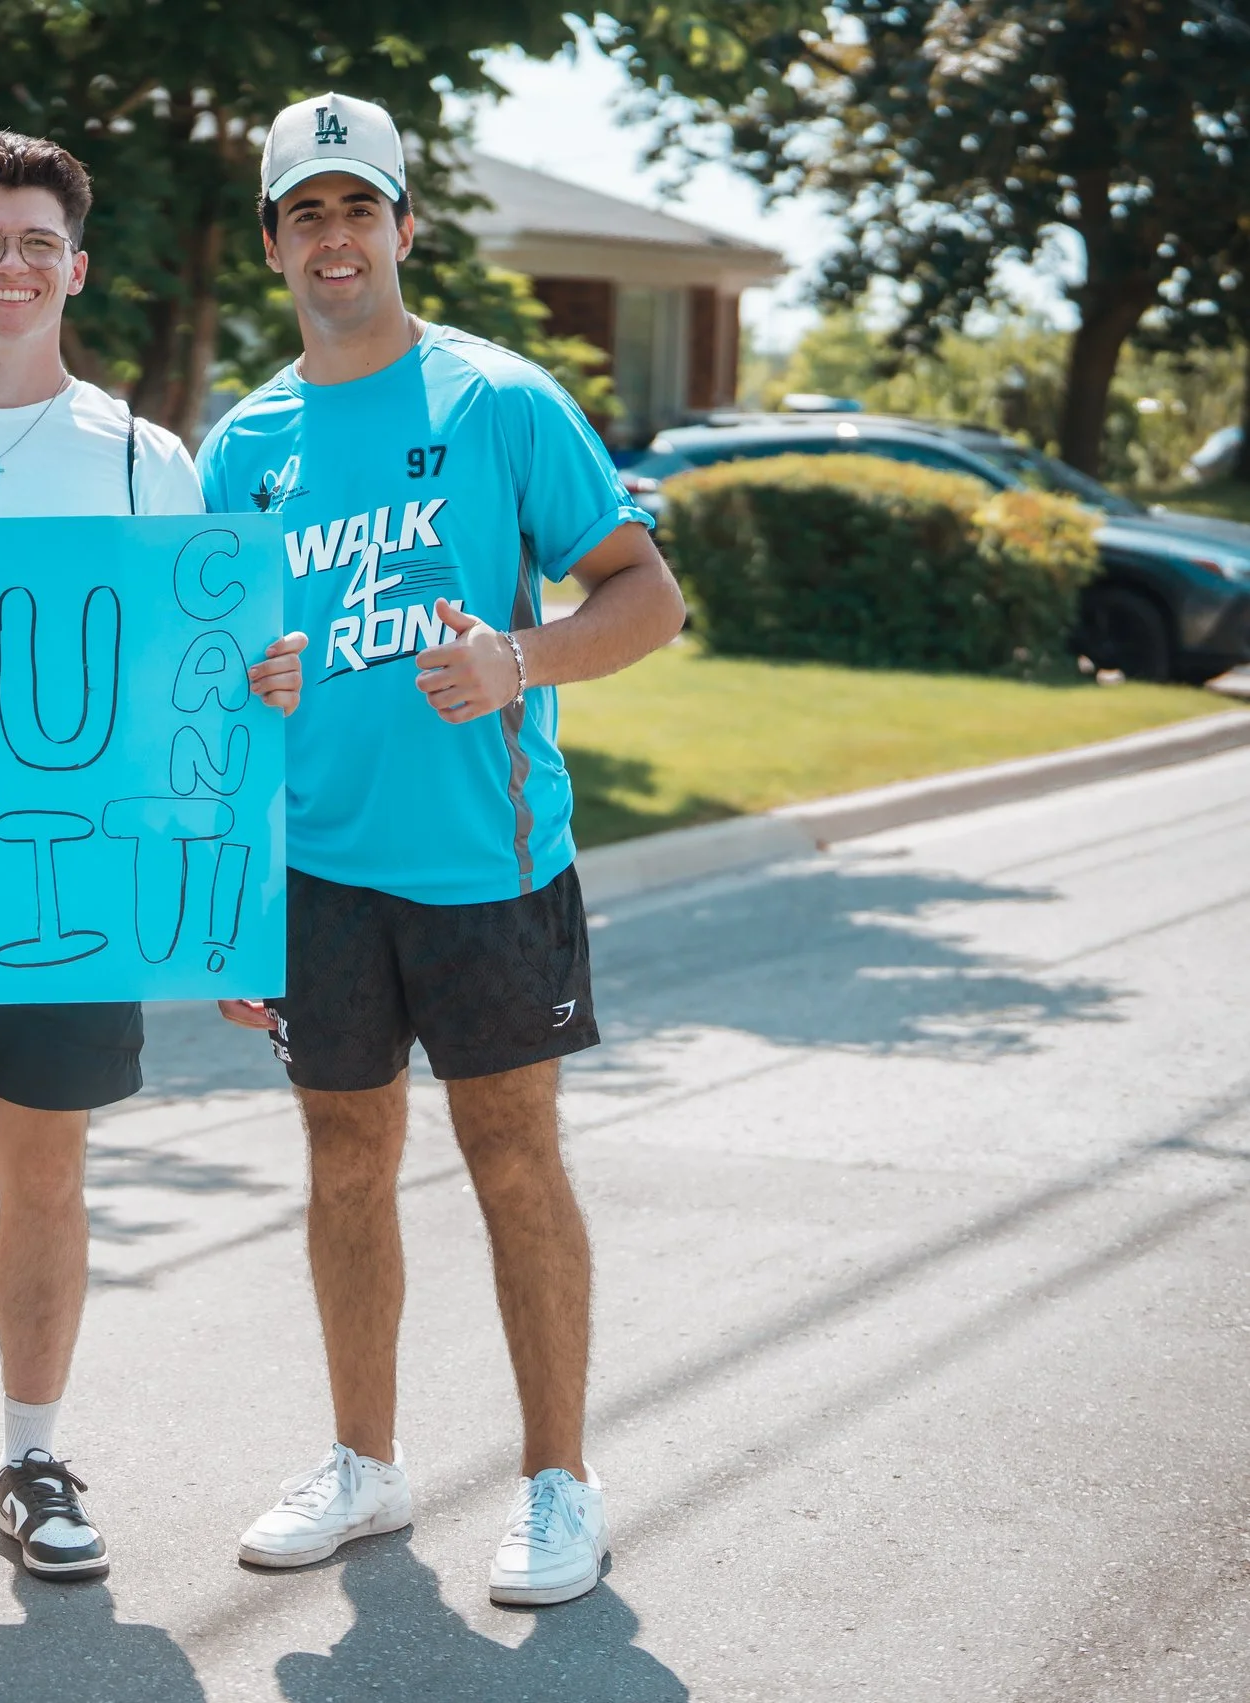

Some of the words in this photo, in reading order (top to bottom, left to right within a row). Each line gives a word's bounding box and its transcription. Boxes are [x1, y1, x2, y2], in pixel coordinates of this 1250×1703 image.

[315, 107, 348, 144] LA
[406, 445, 447, 480] 97
[284, 499, 448, 579] WALK
[343, 542, 404, 617] 4
[169, 529, 251, 796] CAN
